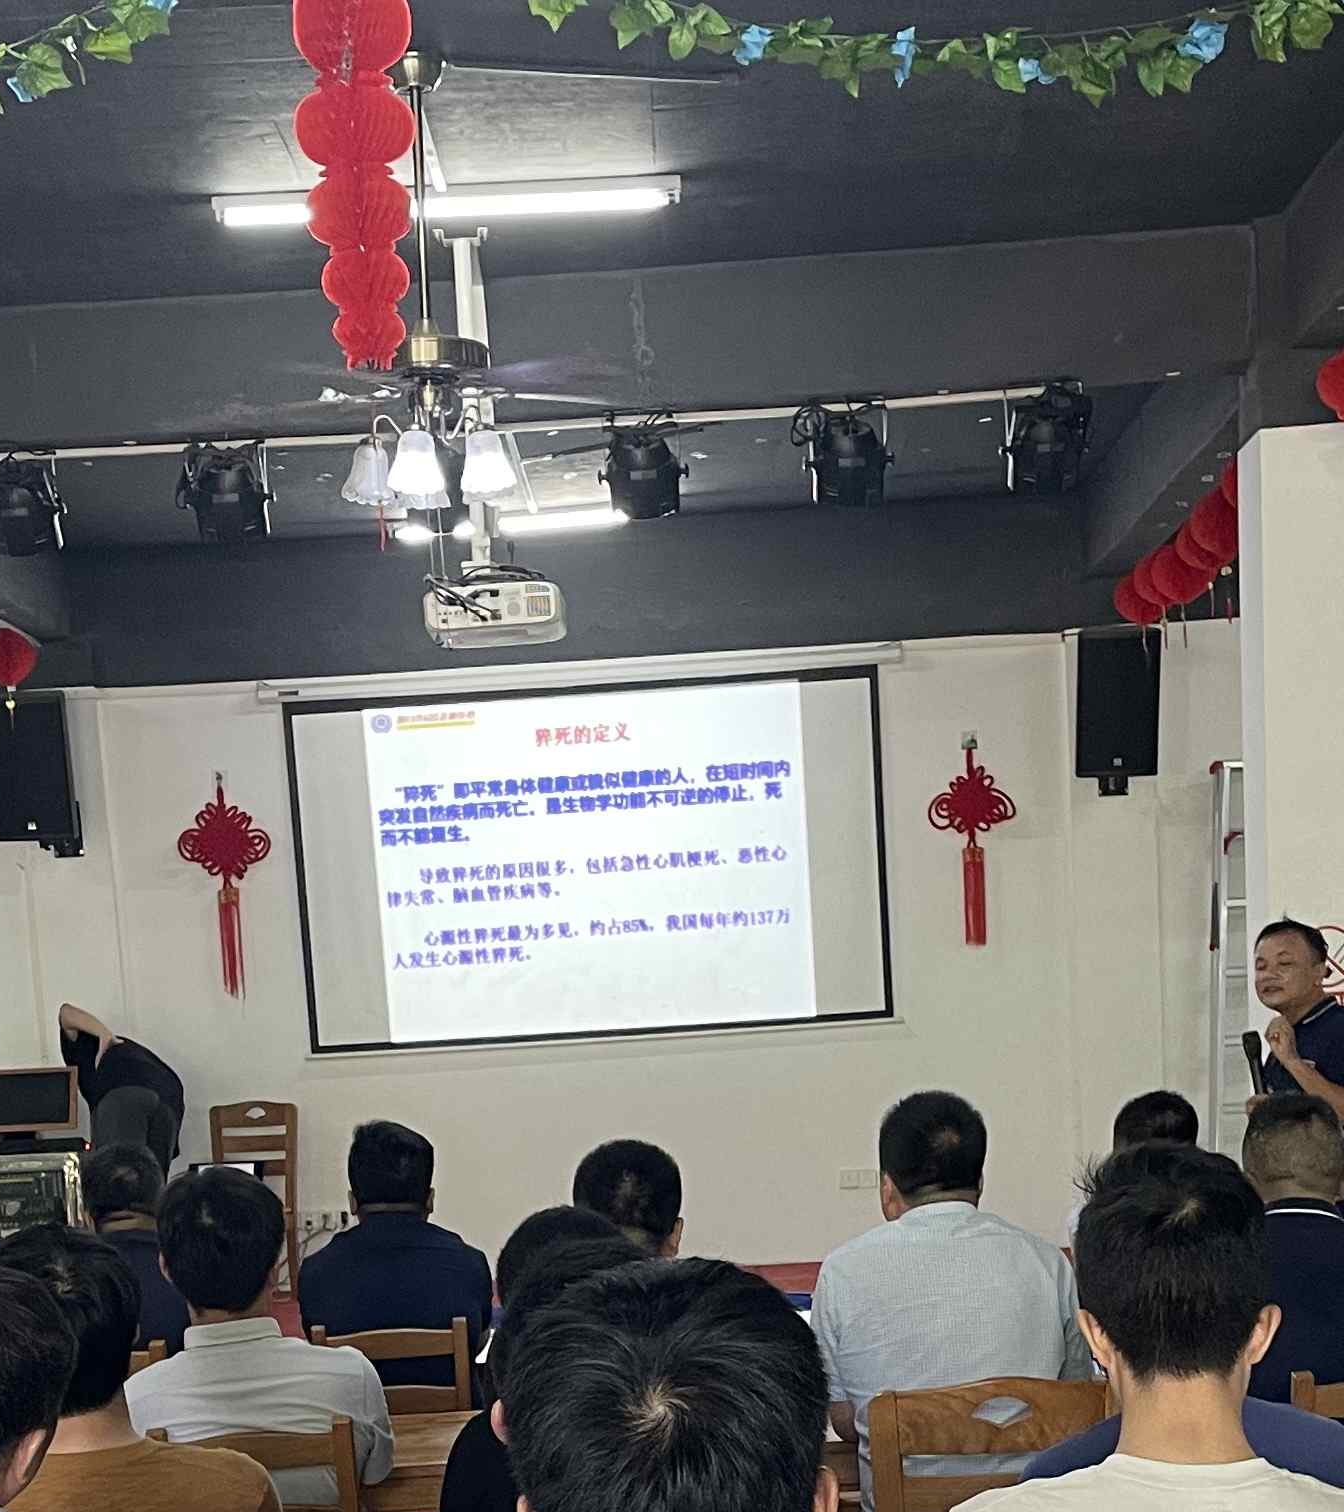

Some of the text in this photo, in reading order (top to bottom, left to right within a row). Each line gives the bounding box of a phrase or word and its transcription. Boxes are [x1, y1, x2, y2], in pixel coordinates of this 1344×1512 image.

[535, 722, 632, 747] 猝死的定义
